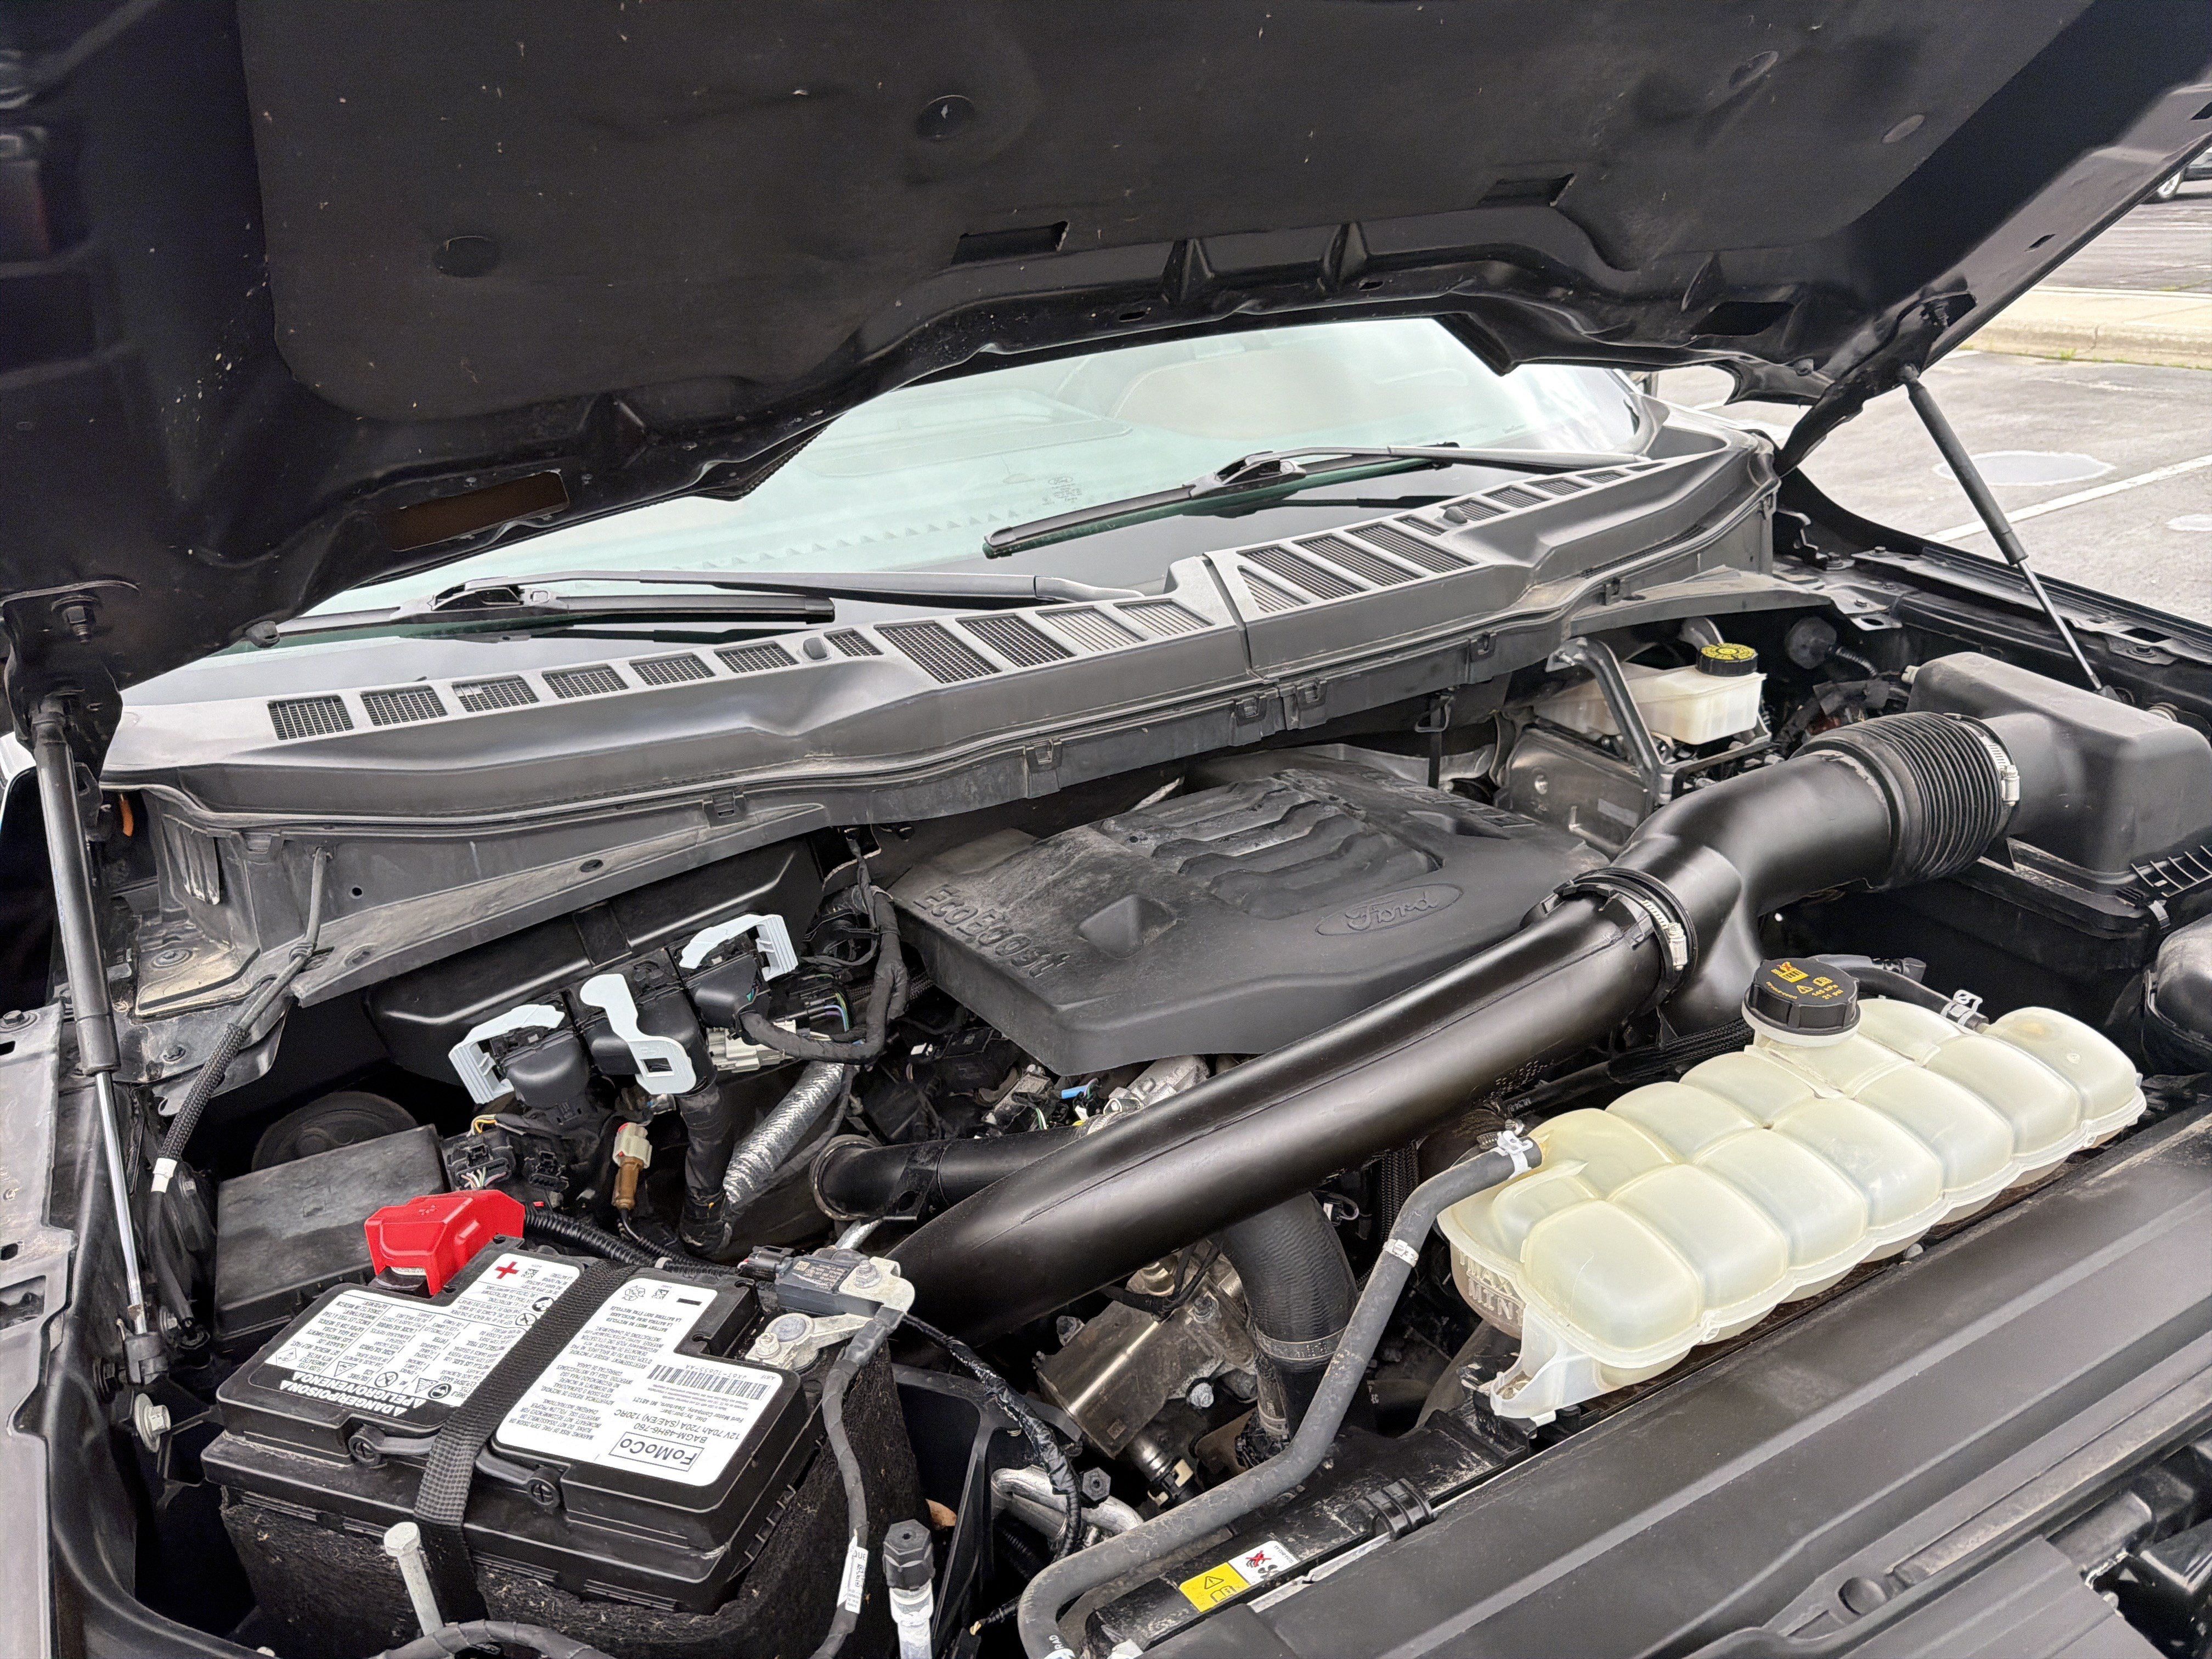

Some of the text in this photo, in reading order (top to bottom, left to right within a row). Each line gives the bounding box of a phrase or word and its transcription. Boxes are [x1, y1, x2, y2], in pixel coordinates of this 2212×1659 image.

[1345, 891, 1440, 931] Ford
[912, 883, 1071, 979] EcoBoost
[1466, 1256, 1513, 1296] MAX
[1468, 1278, 1513, 1320] MIN
[685, 1364, 747, 1379] JX6T-10655-AA
[288, 1383, 393, 1413] DANGER/POISON
[301, 1373, 415, 1406] PELIGRO/VENENO
[529, 1409, 563, 1420] RECOMMENDED
[530, 1402, 549, 1410] PROPER
[549, 1406, 567, 1414] FOLLOW
[516, 1419, 541, 1429] EXPLOSION
[527, 1415, 558, 1426] DISASSEMBLE
[613, 1409, 740, 1440] 12V 70Ah 720A (SAE/EN) 120RC
[633, 1423, 707, 1443] BAGM-48H6-760
[620, 1438, 696, 1465] FoMoCo
